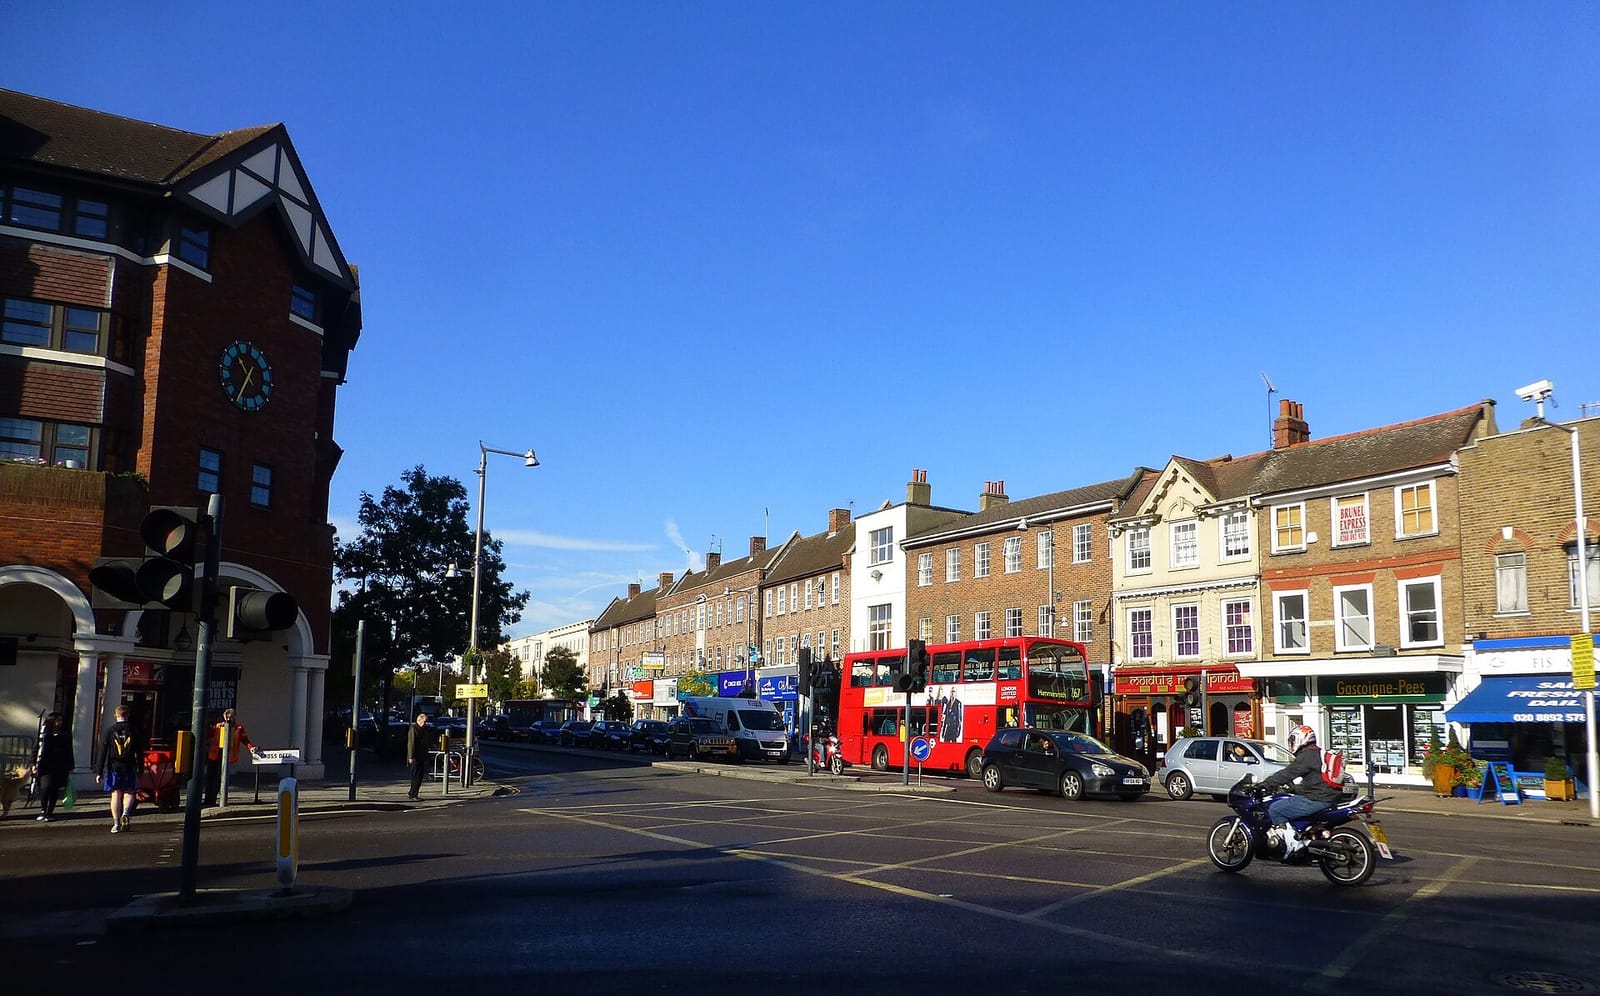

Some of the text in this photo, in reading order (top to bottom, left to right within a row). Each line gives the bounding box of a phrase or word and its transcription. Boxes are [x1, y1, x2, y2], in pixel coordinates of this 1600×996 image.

[1340, 505, 1365, 519] BRUNEL
[1340, 516, 1367, 531] EXPRESS
[122, 664, 140, 677] eys
[1336, 679, 1425, 698] Gascoigne-Pees
[1513, 713, 1534, 722] 020
[1535, 713, 1564, 722] 8892
